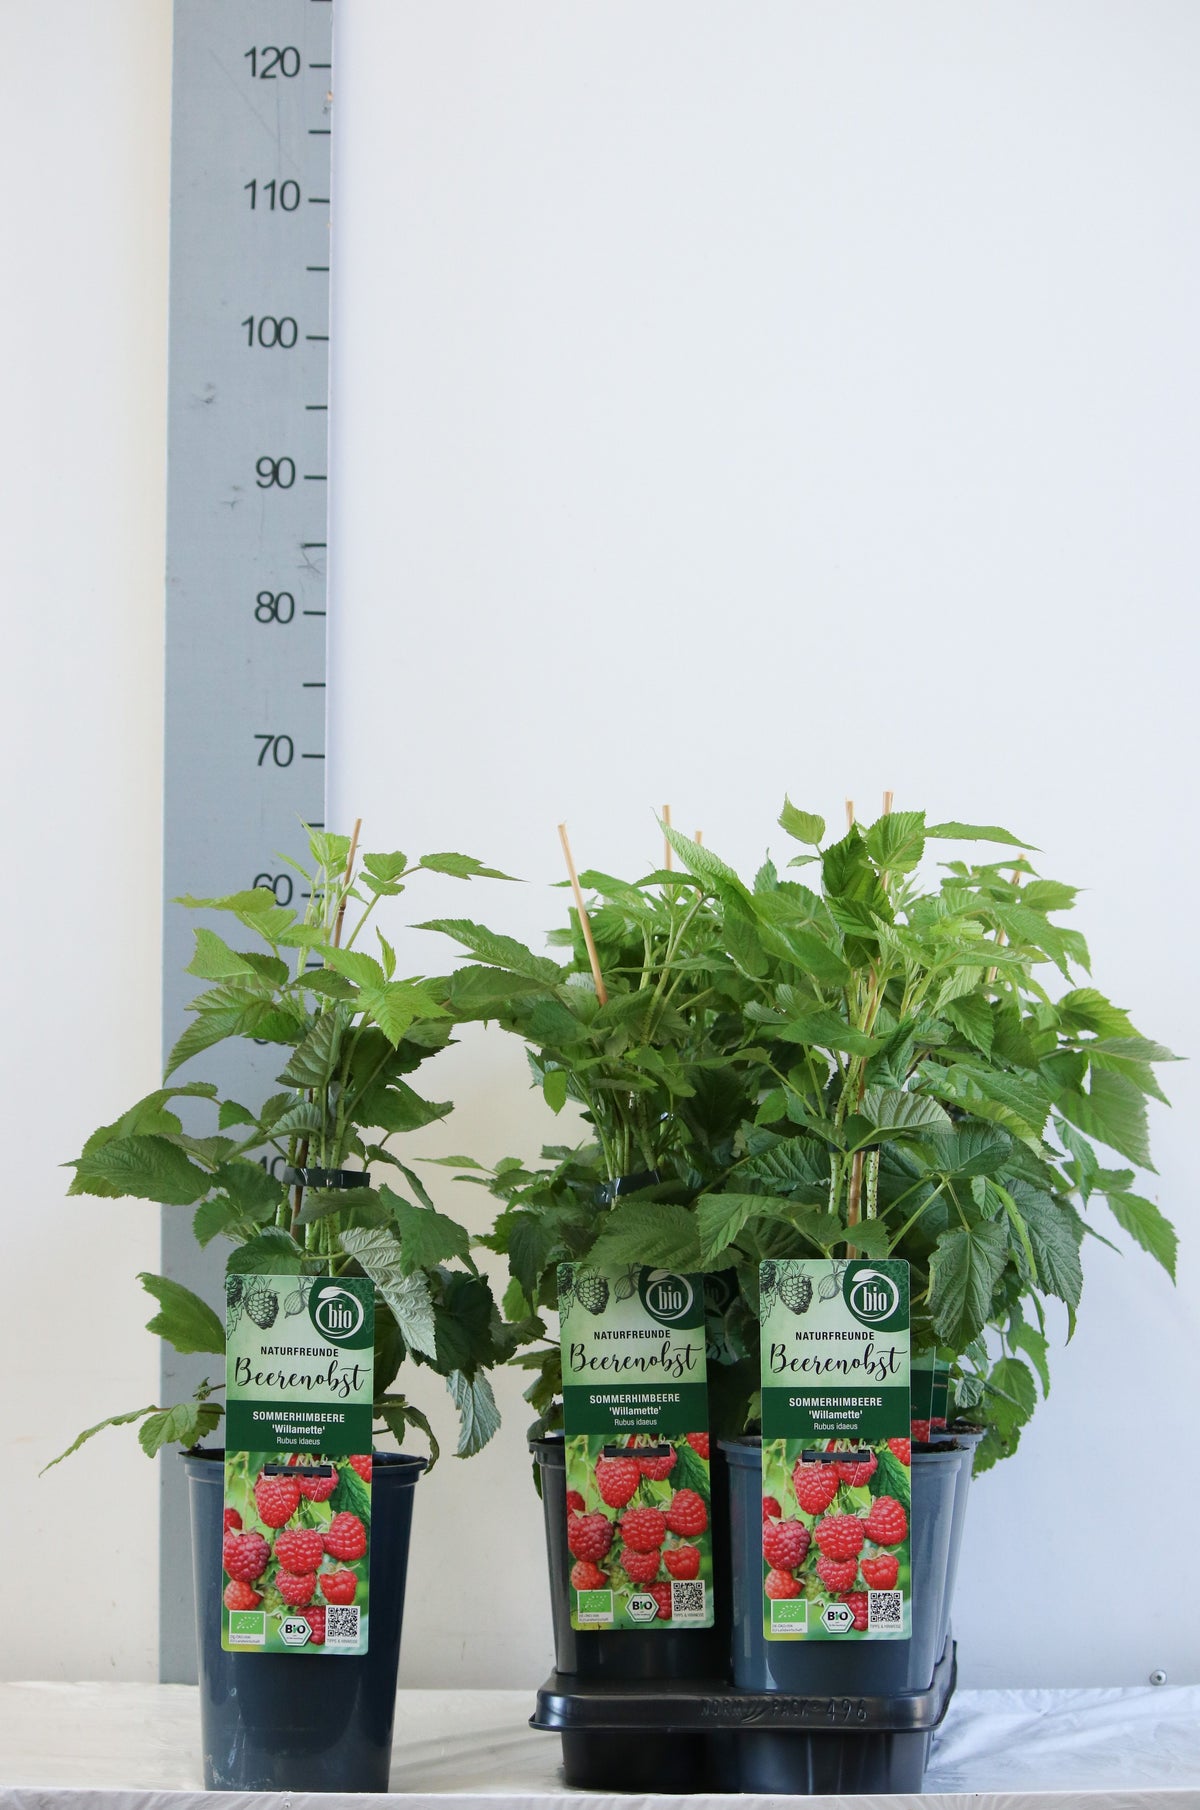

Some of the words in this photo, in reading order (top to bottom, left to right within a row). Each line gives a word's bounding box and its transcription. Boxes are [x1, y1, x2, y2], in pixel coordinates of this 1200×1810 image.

[243, 46, 301, 79] 120
[243, 179, 301, 212] 110
[241, 316, 298, 350] 100
[255, 456, 296, 490] 90
[254, 591, 295, 625] 80
[254, 734, 294, 768] 70
[658, 1285, 682, 1310] bio
[862, 1286, 887, 1312] bio
[328, 1303, 352, 1329] bio
[594, 1329, 671, 1340] NATURFREUNDE
[795, 1331, 875, 1341] NATURFREUNDE
[260, 1346, 339, 1357] NATURFREUNDE
[570, 1340, 703, 1378] Beerenobst
[770, 1343, 908, 1381] Beerenobst
[235, 1356, 372, 1398] Beerenobst
[589, 1393, 680, 1404] SOMMERHIMBEERE
[789, 1397, 883, 1407] SOMMERHIMBEERE
[252, 1411, 345, 1423] SOMMERHIMBEERE
[609, 1407, 662, 1416] 'Willamette'
[614, 1418, 635, 1426] Rubus
[636, 1418, 657, 1426] idaeus
[808, 1410, 863, 1419] 'Willamette'
[272, 1424, 325, 1435] 'Willamette'
[813, 1422, 835, 1431] Rubus
[836, 1422, 858, 1431] idaeus
[276, 1436, 297, 1445] Rubus
[298, 1436, 320, 1446] idaeus
[826, 1698, 867, 1723] 496
